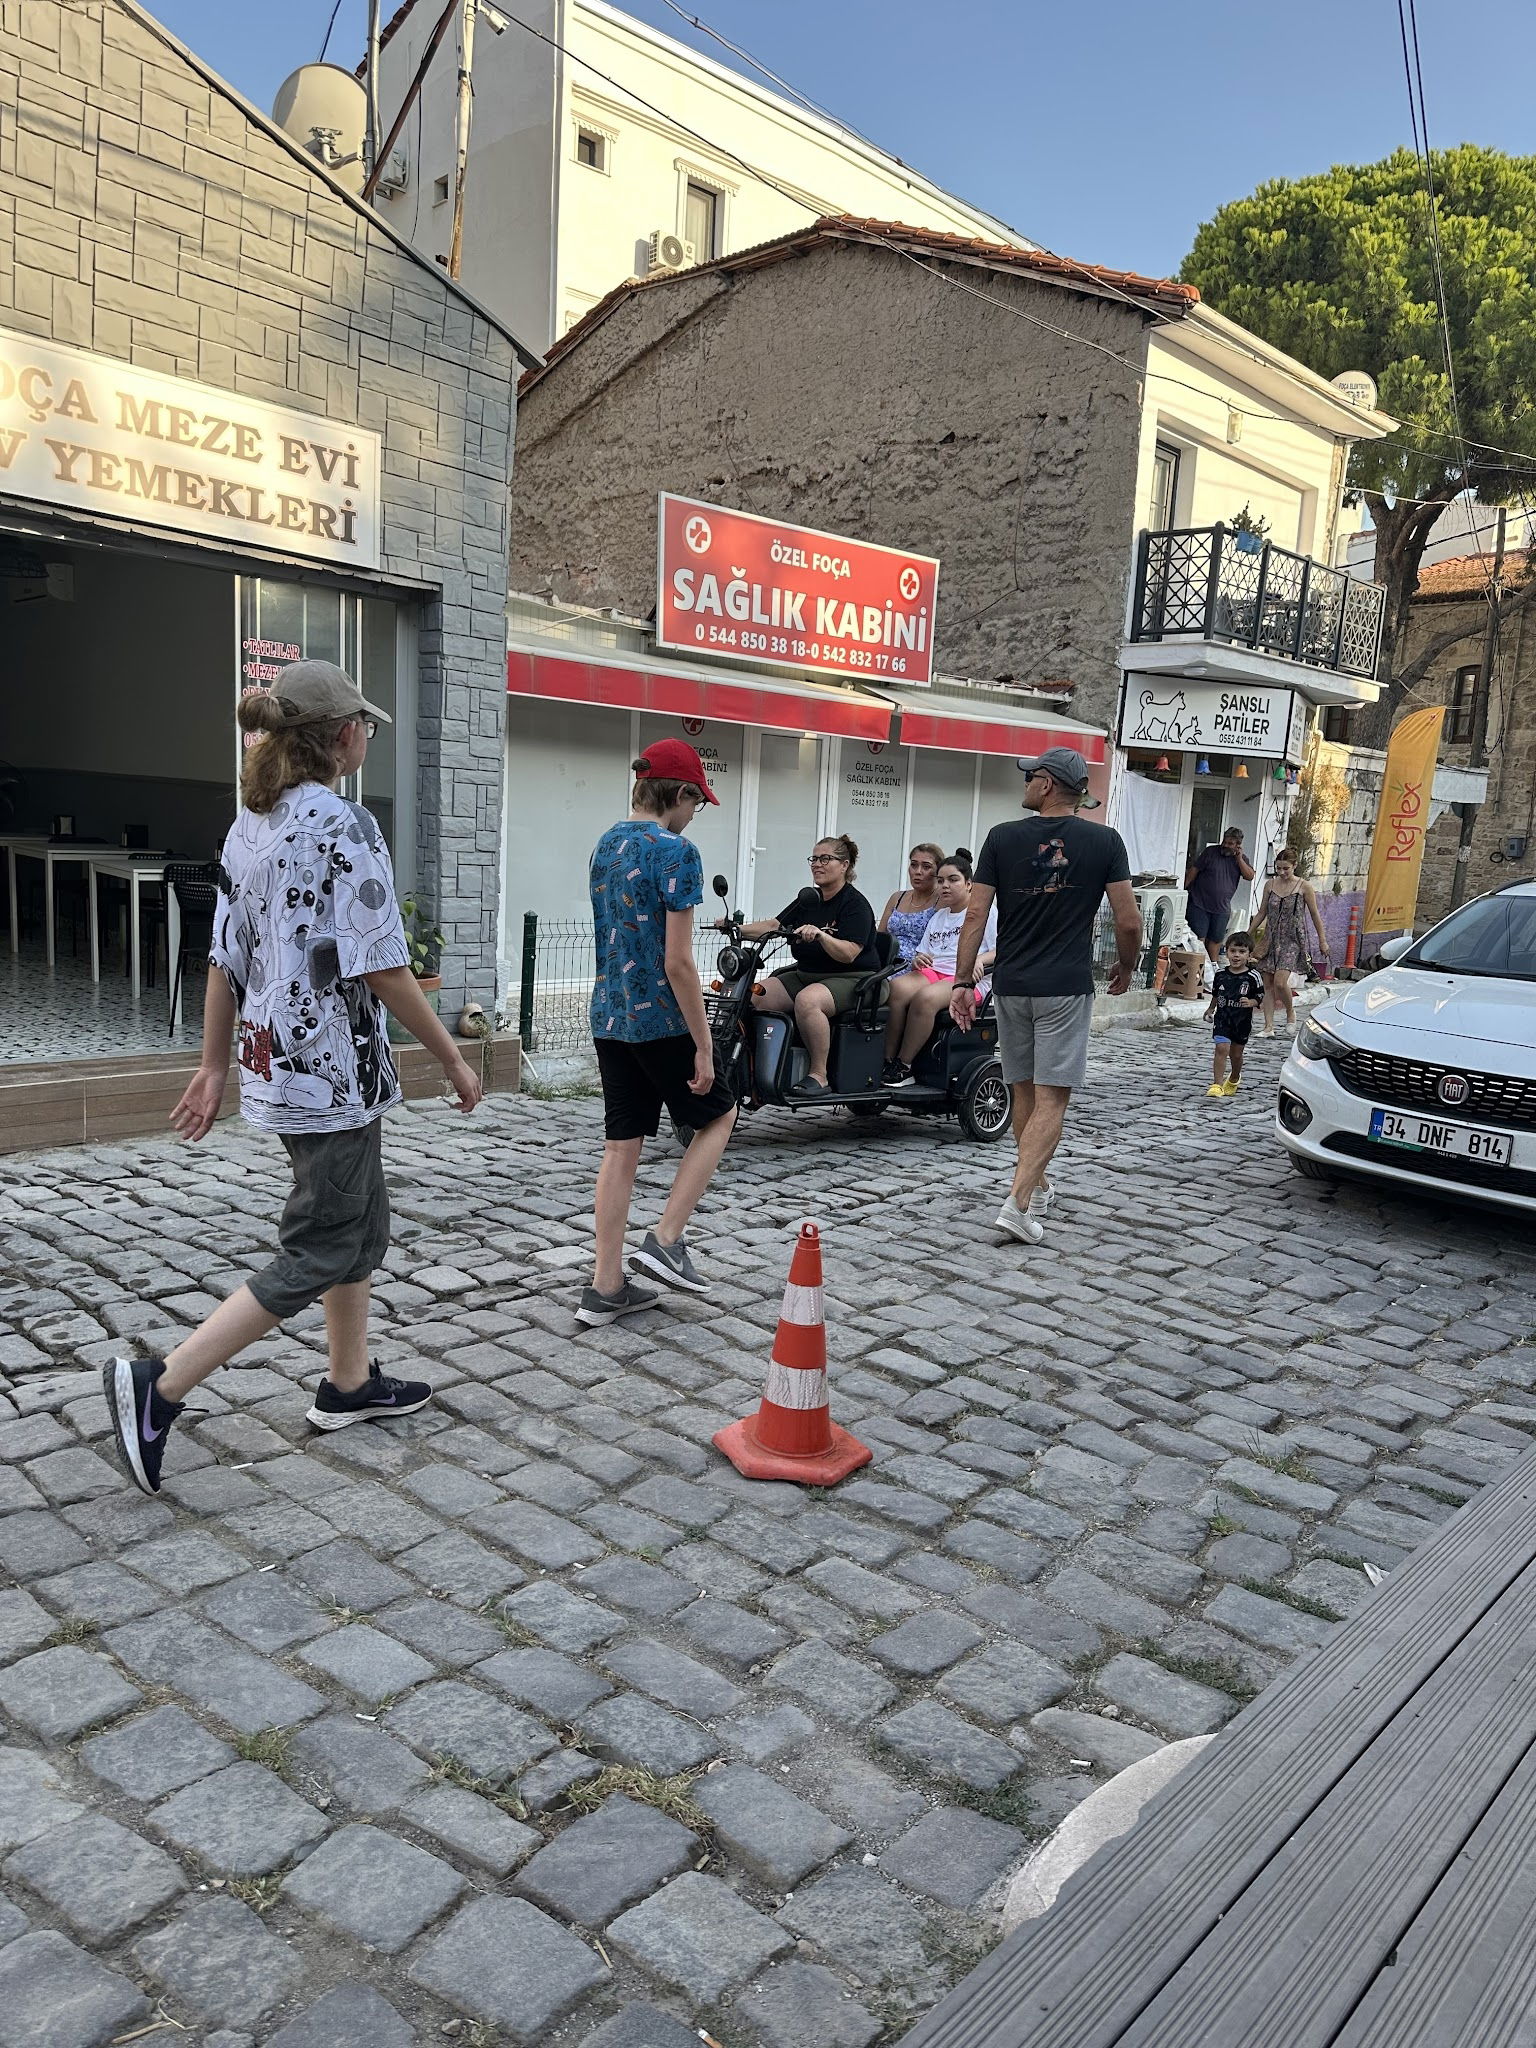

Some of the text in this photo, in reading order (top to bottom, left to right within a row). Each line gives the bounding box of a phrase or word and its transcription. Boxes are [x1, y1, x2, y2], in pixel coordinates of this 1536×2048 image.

[115, 392, 264, 464] MEZE
[279, 434, 360, 490] EVİ
[44, 438, 358, 545] YEMEKLERİ
[770, 539, 851, 580] ÖZEL FOÇA
[672, 565, 927, 653] SAĞLIK KABİNİ
[248, 637, 300, 661] TATLILAR
[695, 624, 705, 641] 0
[709, 626, 737, 646] 544
[740, 631, 767, 650] 850
[771, 636, 787, 655] 38
[823, 646, 846, 663] 542
[849, 650, 872, 667] 832
[876, 654, 889, 669] 17
[891, 656, 906, 673] 66
[247, 661, 284, 681] MEZE
[1220, 693, 1270, 714] ŞANSLI
[1214, 713, 1270, 735] PATİLER
[1219, 734, 1235, 744] 0552
[701, 761, 728, 773] ABİNİ
[855, 760, 894, 774] ÖZEL FOÇA
[846, 773, 874, 785] SAĞLIK
[1386, 782, 1423, 862] Reflex
[1444, 1083, 1463, 1099] FIAT
[1384, 1116, 1406, 1139] 34
[1417, 1122, 1456, 1149] DNF
[1468, 1133, 1503, 1160] 814
